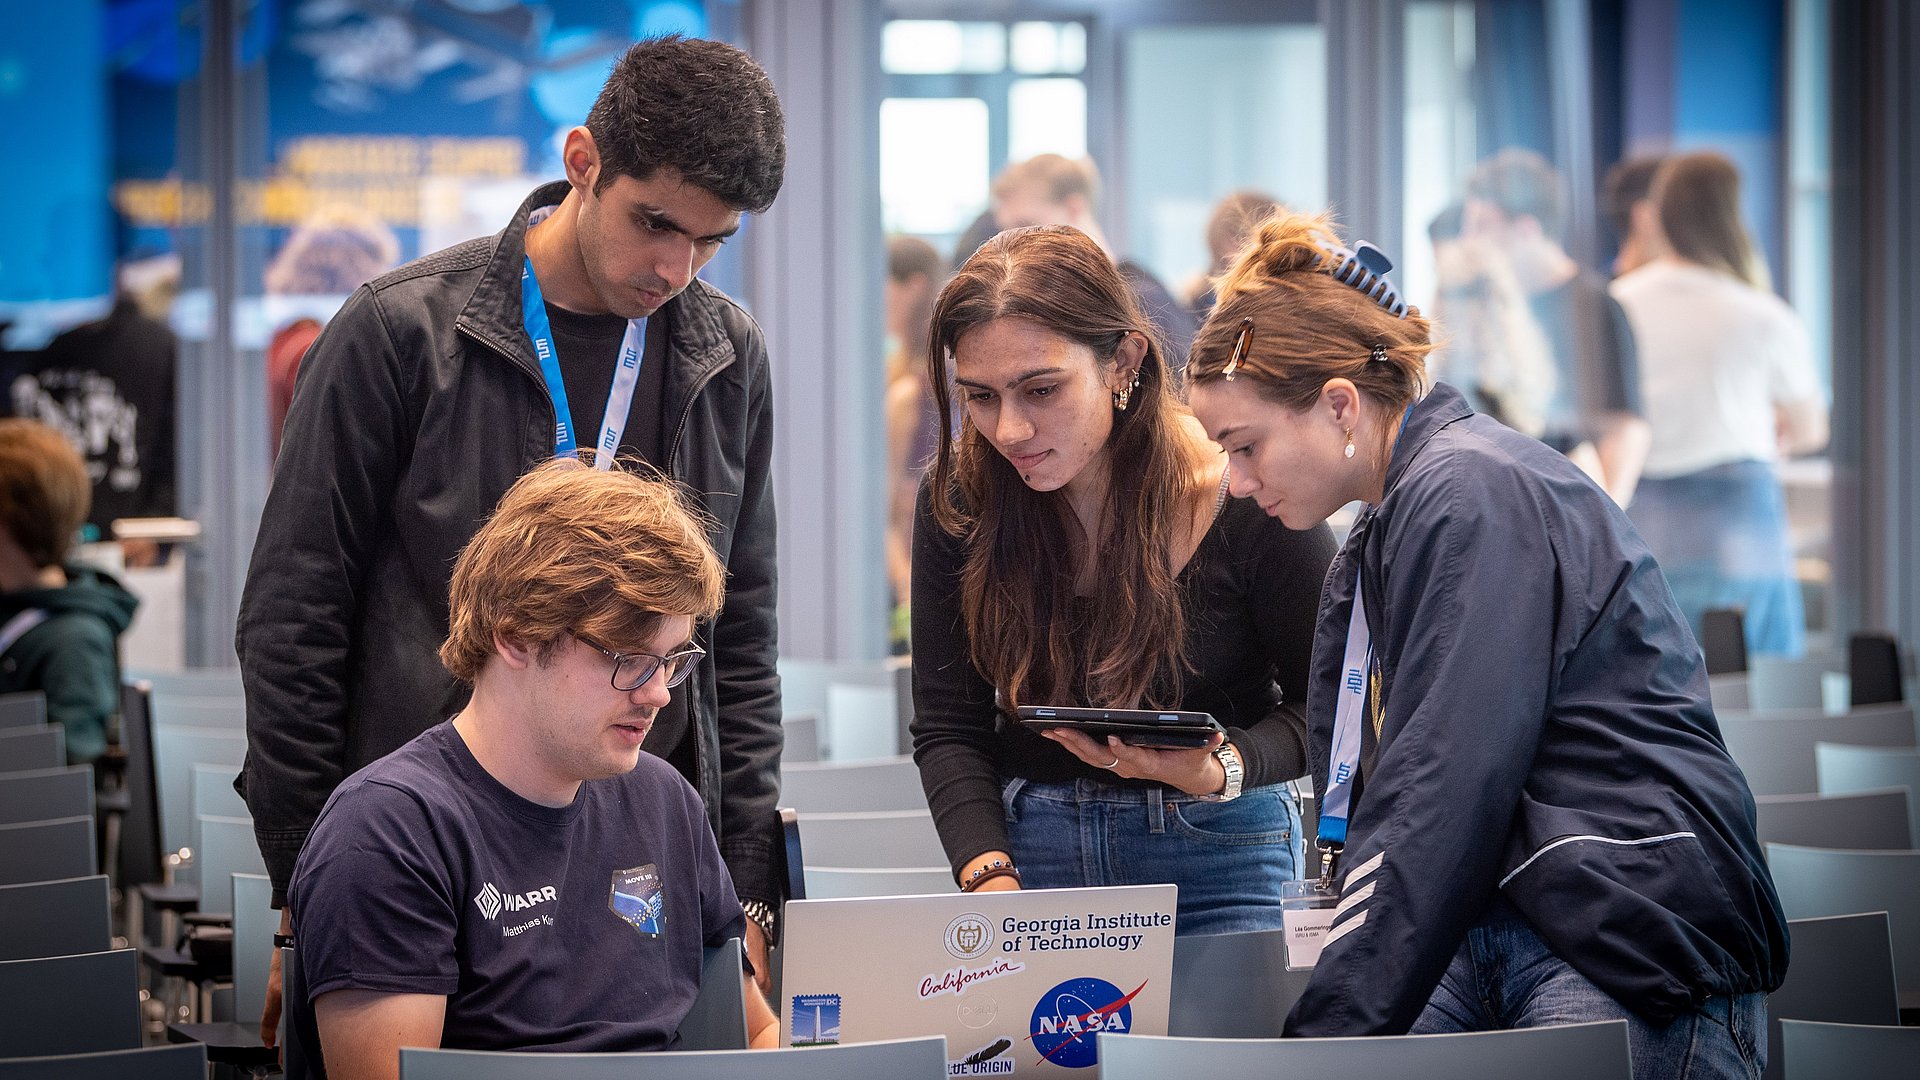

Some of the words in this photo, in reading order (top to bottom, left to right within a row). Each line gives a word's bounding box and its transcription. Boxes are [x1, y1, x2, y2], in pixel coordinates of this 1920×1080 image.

[625, 875, 645, 885] MOVE
[502, 886, 557, 912] WARR
[502, 918, 541, 937] Matthias
[1002, 915, 1081, 935] Georgia
[1086, 912, 1172, 930] Institute
[1002, 936, 1022, 952] of
[1027, 933, 1144, 951] Technology
[920, 960, 1021, 997] California
[1039, 1012, 1126, 1035] NASA
[947, 1062, 968, 1075] LUE
[972, 1060, 1012, 1074] ORIGIN
